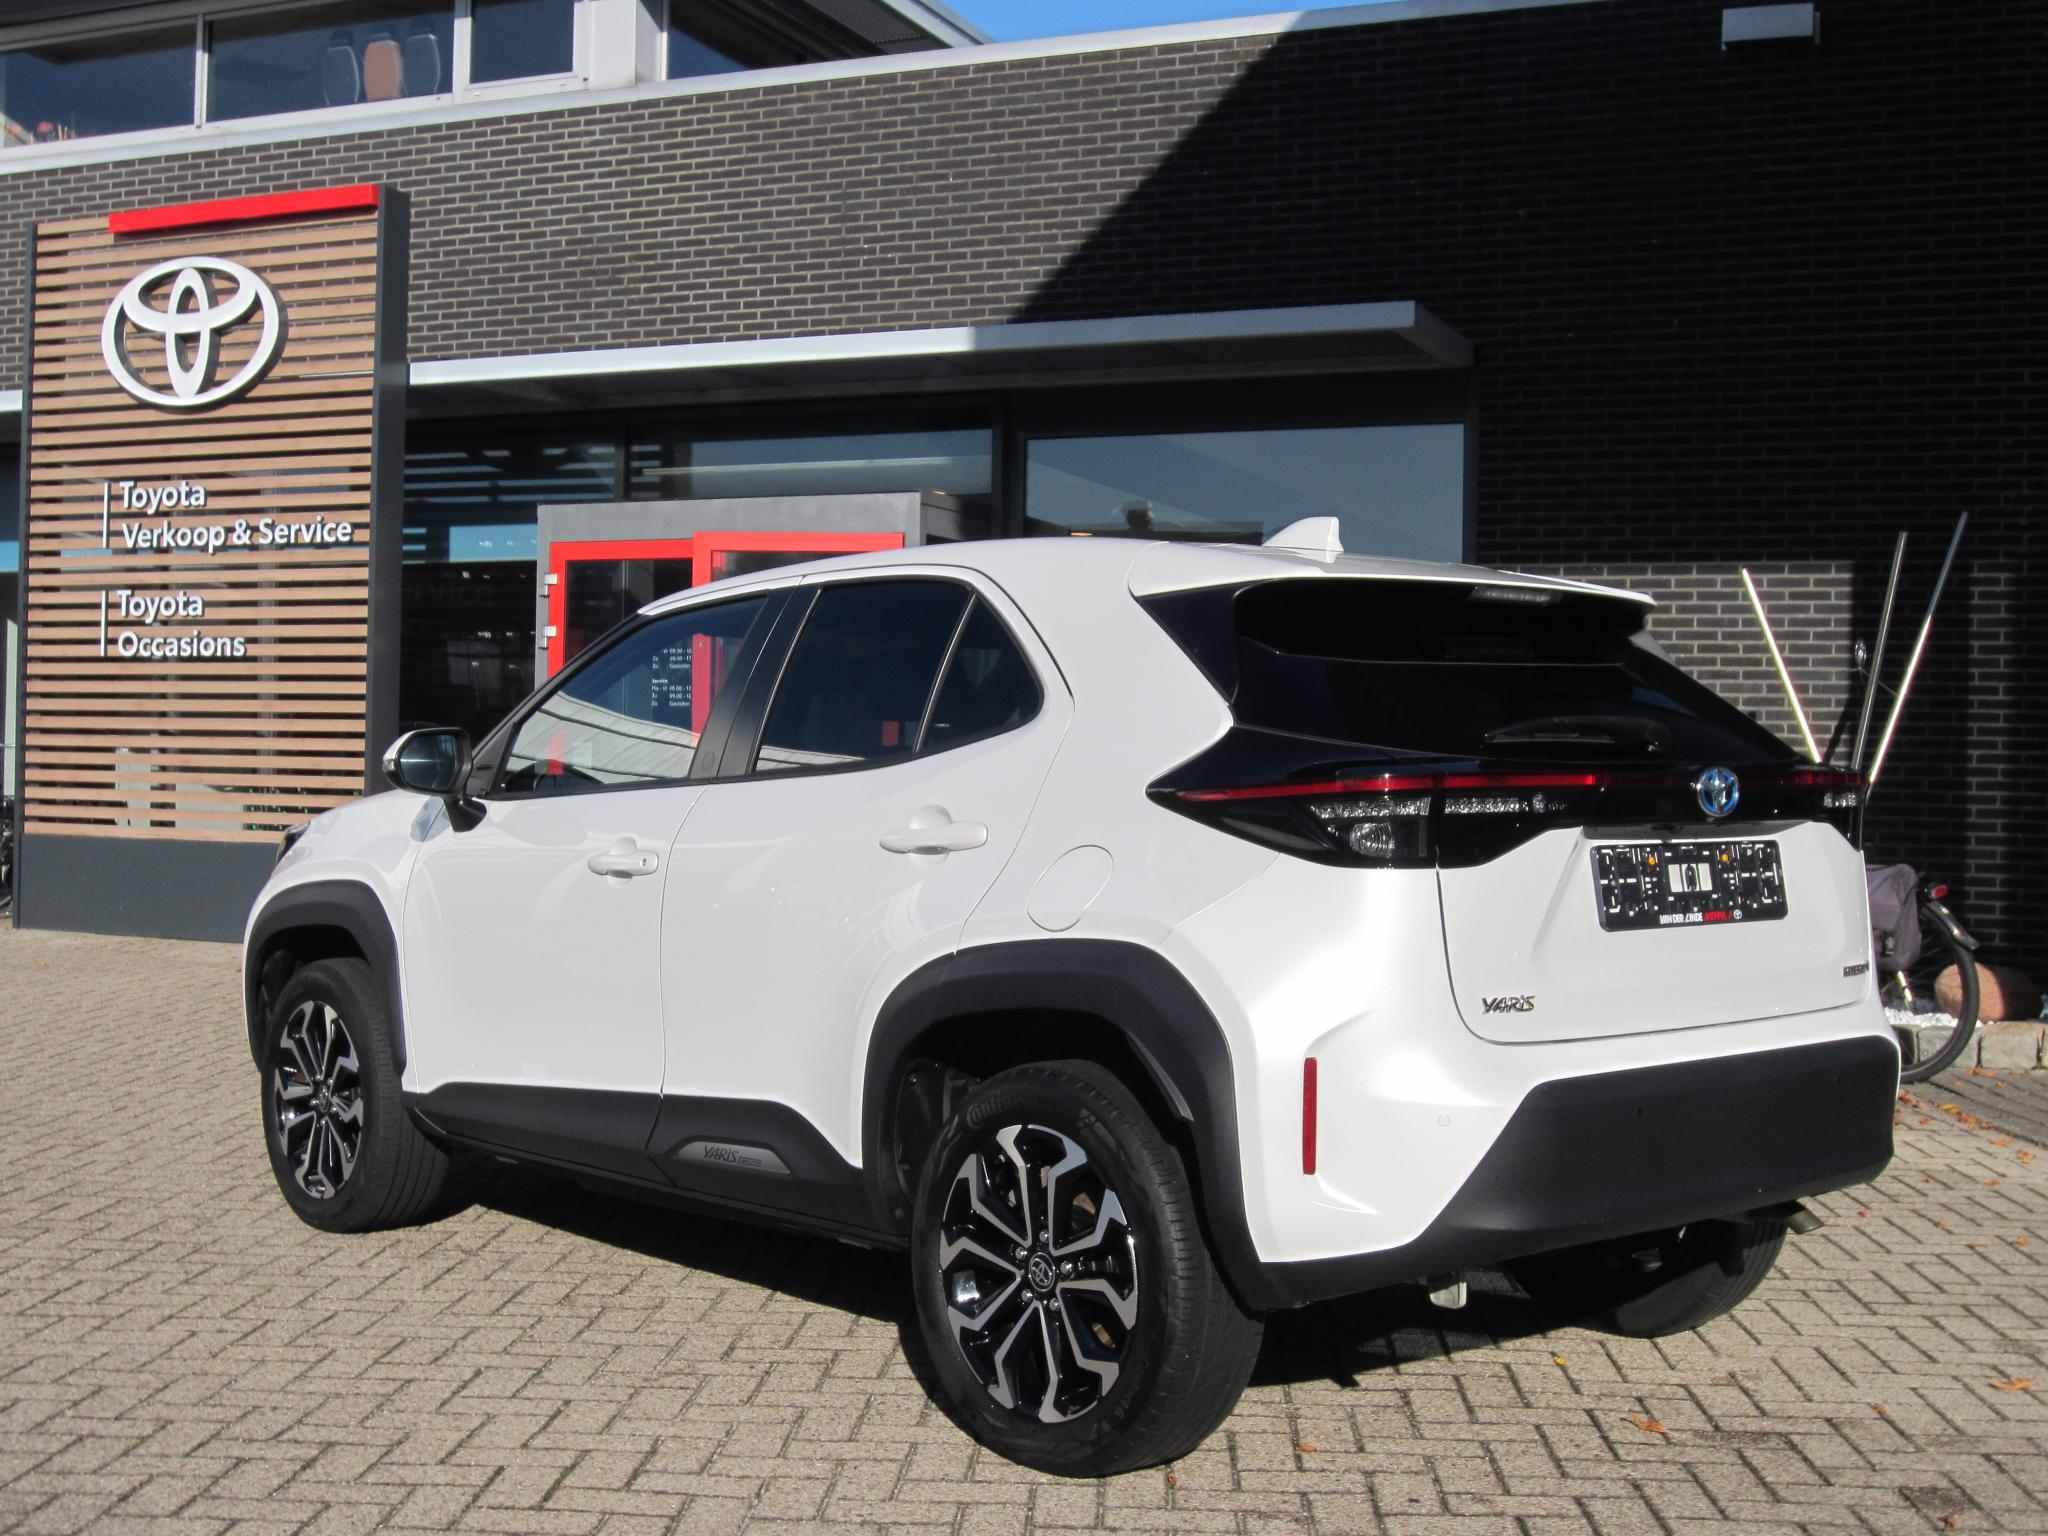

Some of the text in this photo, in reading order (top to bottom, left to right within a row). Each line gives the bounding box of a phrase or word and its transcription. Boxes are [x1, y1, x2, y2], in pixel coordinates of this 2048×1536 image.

[119, 481, 207, 515] Toyota
[122, 515, 354, 554] Verkoop & Service
[117, 589, 204, 624] Toyota
[117, 629, 246, 658] Occasions
